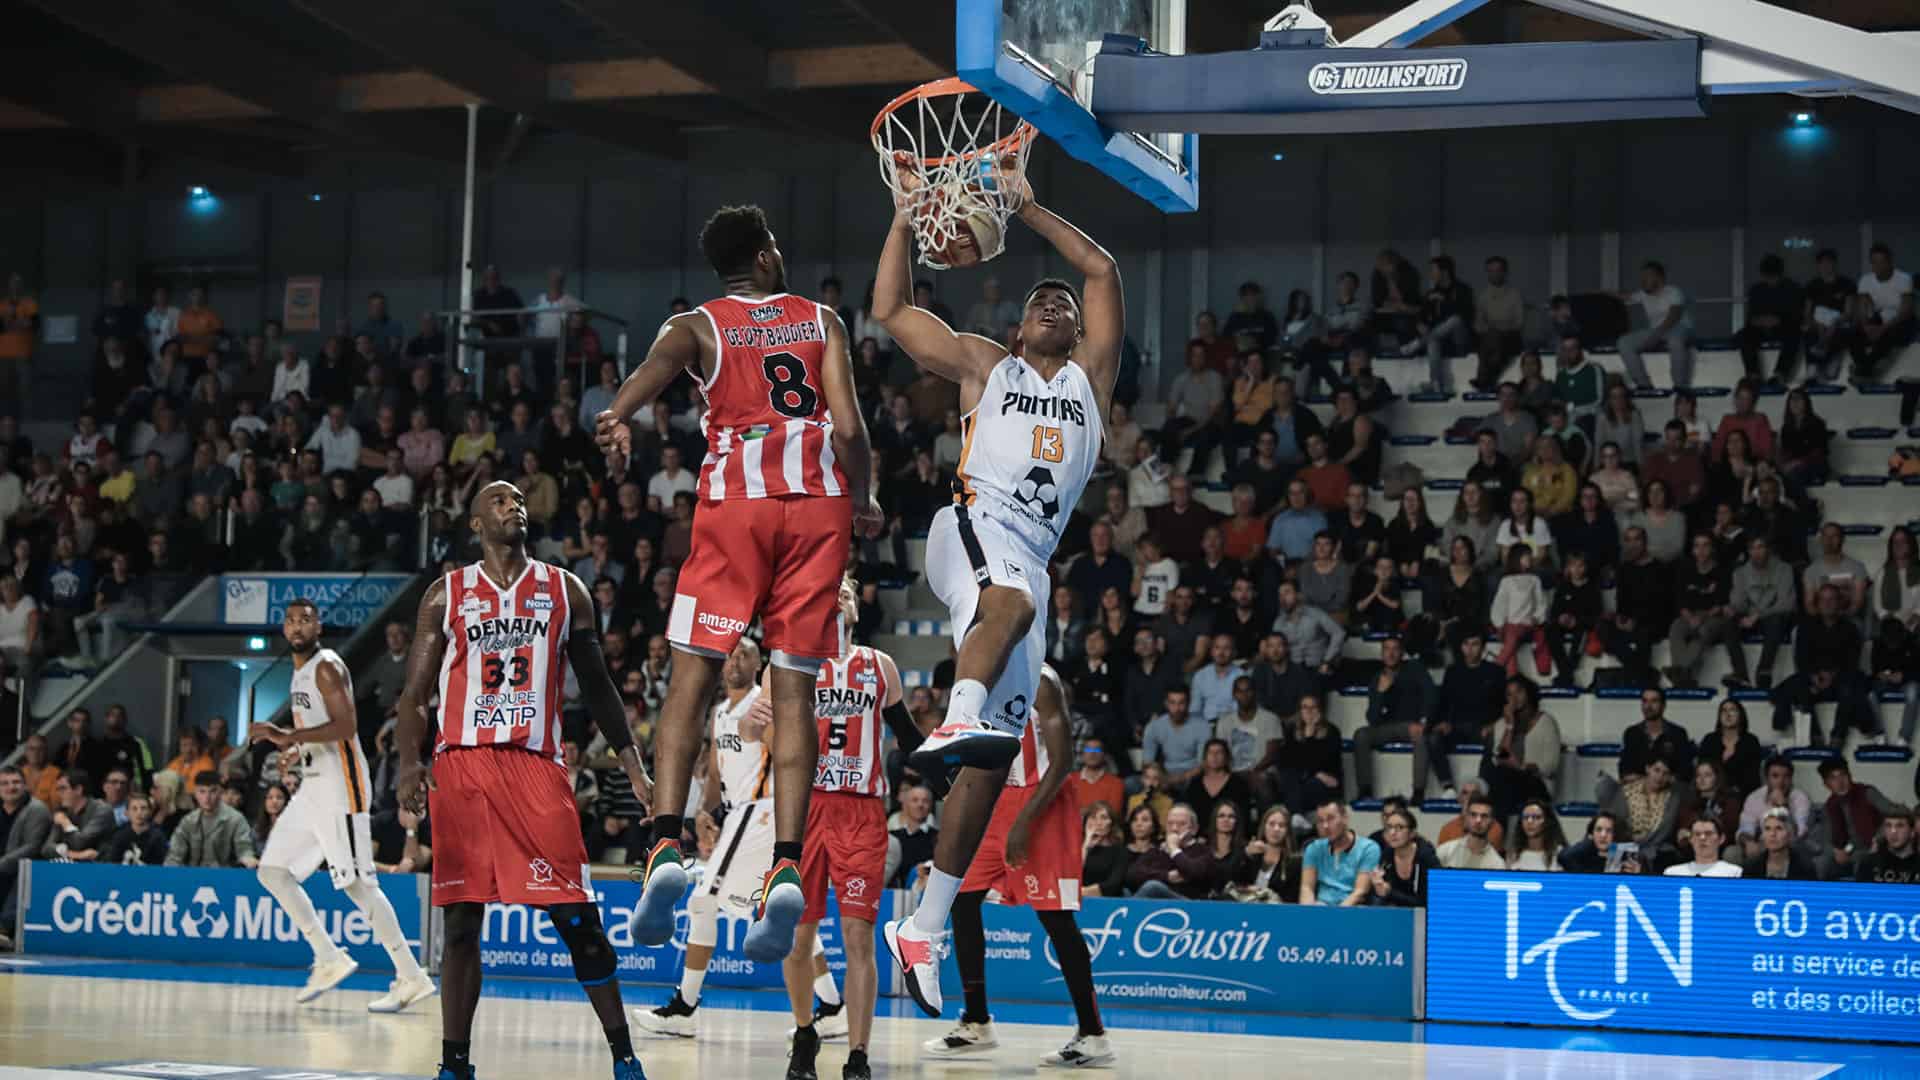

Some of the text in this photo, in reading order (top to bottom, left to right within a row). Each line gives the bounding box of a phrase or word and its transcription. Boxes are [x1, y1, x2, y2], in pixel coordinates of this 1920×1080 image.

[1341, 64, 1461, 89] NOUANSPORT
[762, 352, 817, 418] 8
[1002, 392, 1085, 426] POITIRS
[1032, 424, 1064, 464] 13
[272, 584, 296, 604] LA
[303, 583, 394, 606] PASSION
[526, 599, 554, 609] Nord
[467, 618, 549, 642] DENAIN
[484, 655, 530, 689] 33
[474, 692, 537, 707] GROUPE
[818, 687, 877, 711] ENAIN
[473, 706, 538, 727] RATP
[828, 722, 849, 750] 5
[818, 755, 864, 769] ROUPE
[53, 887, 384, 945] Crédit Muue
[1754, 899, 1808, 938] 60
[1133, 908, 1270, 962] Cousin
[1277, 946, 1404, 967] 05.49.41.09.14
[481, 951, 528, 967] agence
[531, 950, 549, 966] de
[708, 956, 754, 974] oitiers
[1752, 953, 1784, 973] au
[1792, 951, 1885, 976] service
[1578, 989, 1649, 1004] FRANCE
[1751, 987, 1777, 1009] et
[1783, 986, 1831, 1011] des
